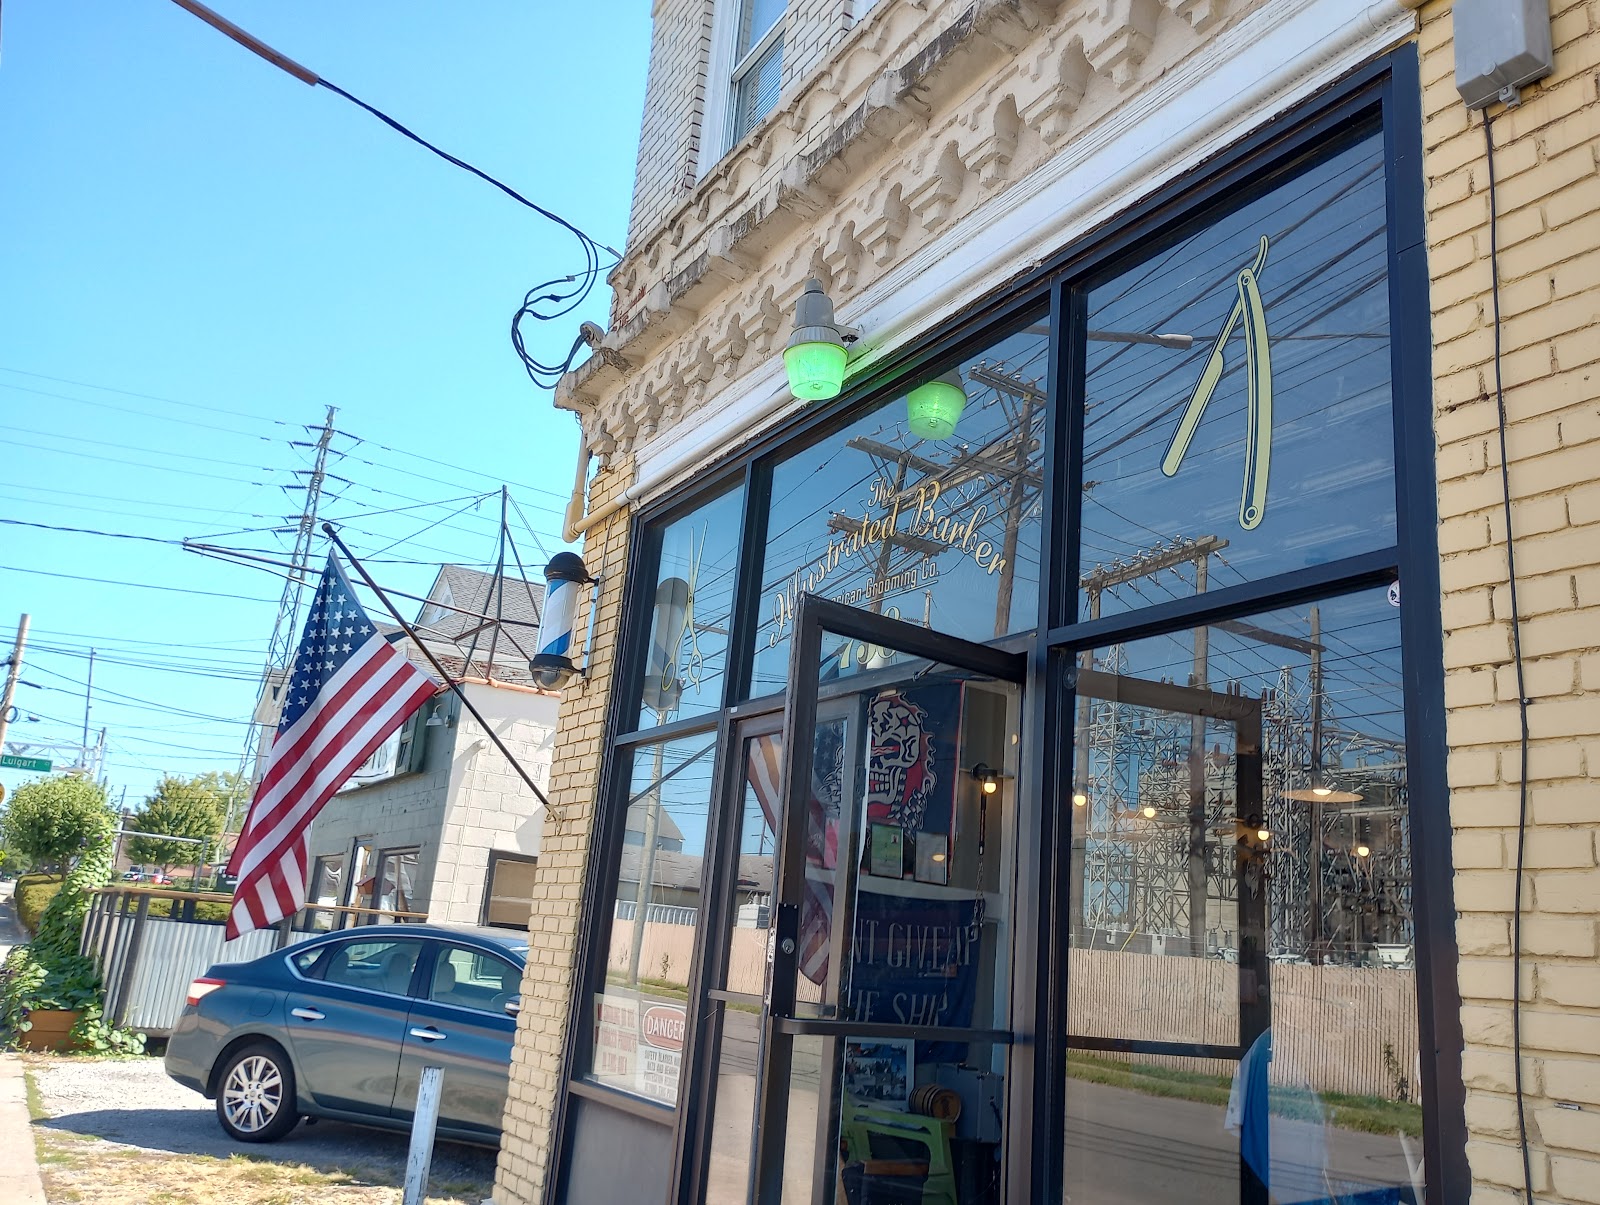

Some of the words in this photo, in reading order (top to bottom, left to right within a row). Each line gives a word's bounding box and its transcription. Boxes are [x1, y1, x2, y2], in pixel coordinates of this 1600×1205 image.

[868, 476, 895, 507] The
[909, 480, 1007, 575] Barber
[866, 568, 918, 599] Grooming
[921, 561, 939, 579] Co.
[2, 755, 37, 767] Luigart
[887, 922, 945, 969] GIVE
[892, 991, 948, 1026] SHIP
[646, 1015, 685, 1040] DANGER
